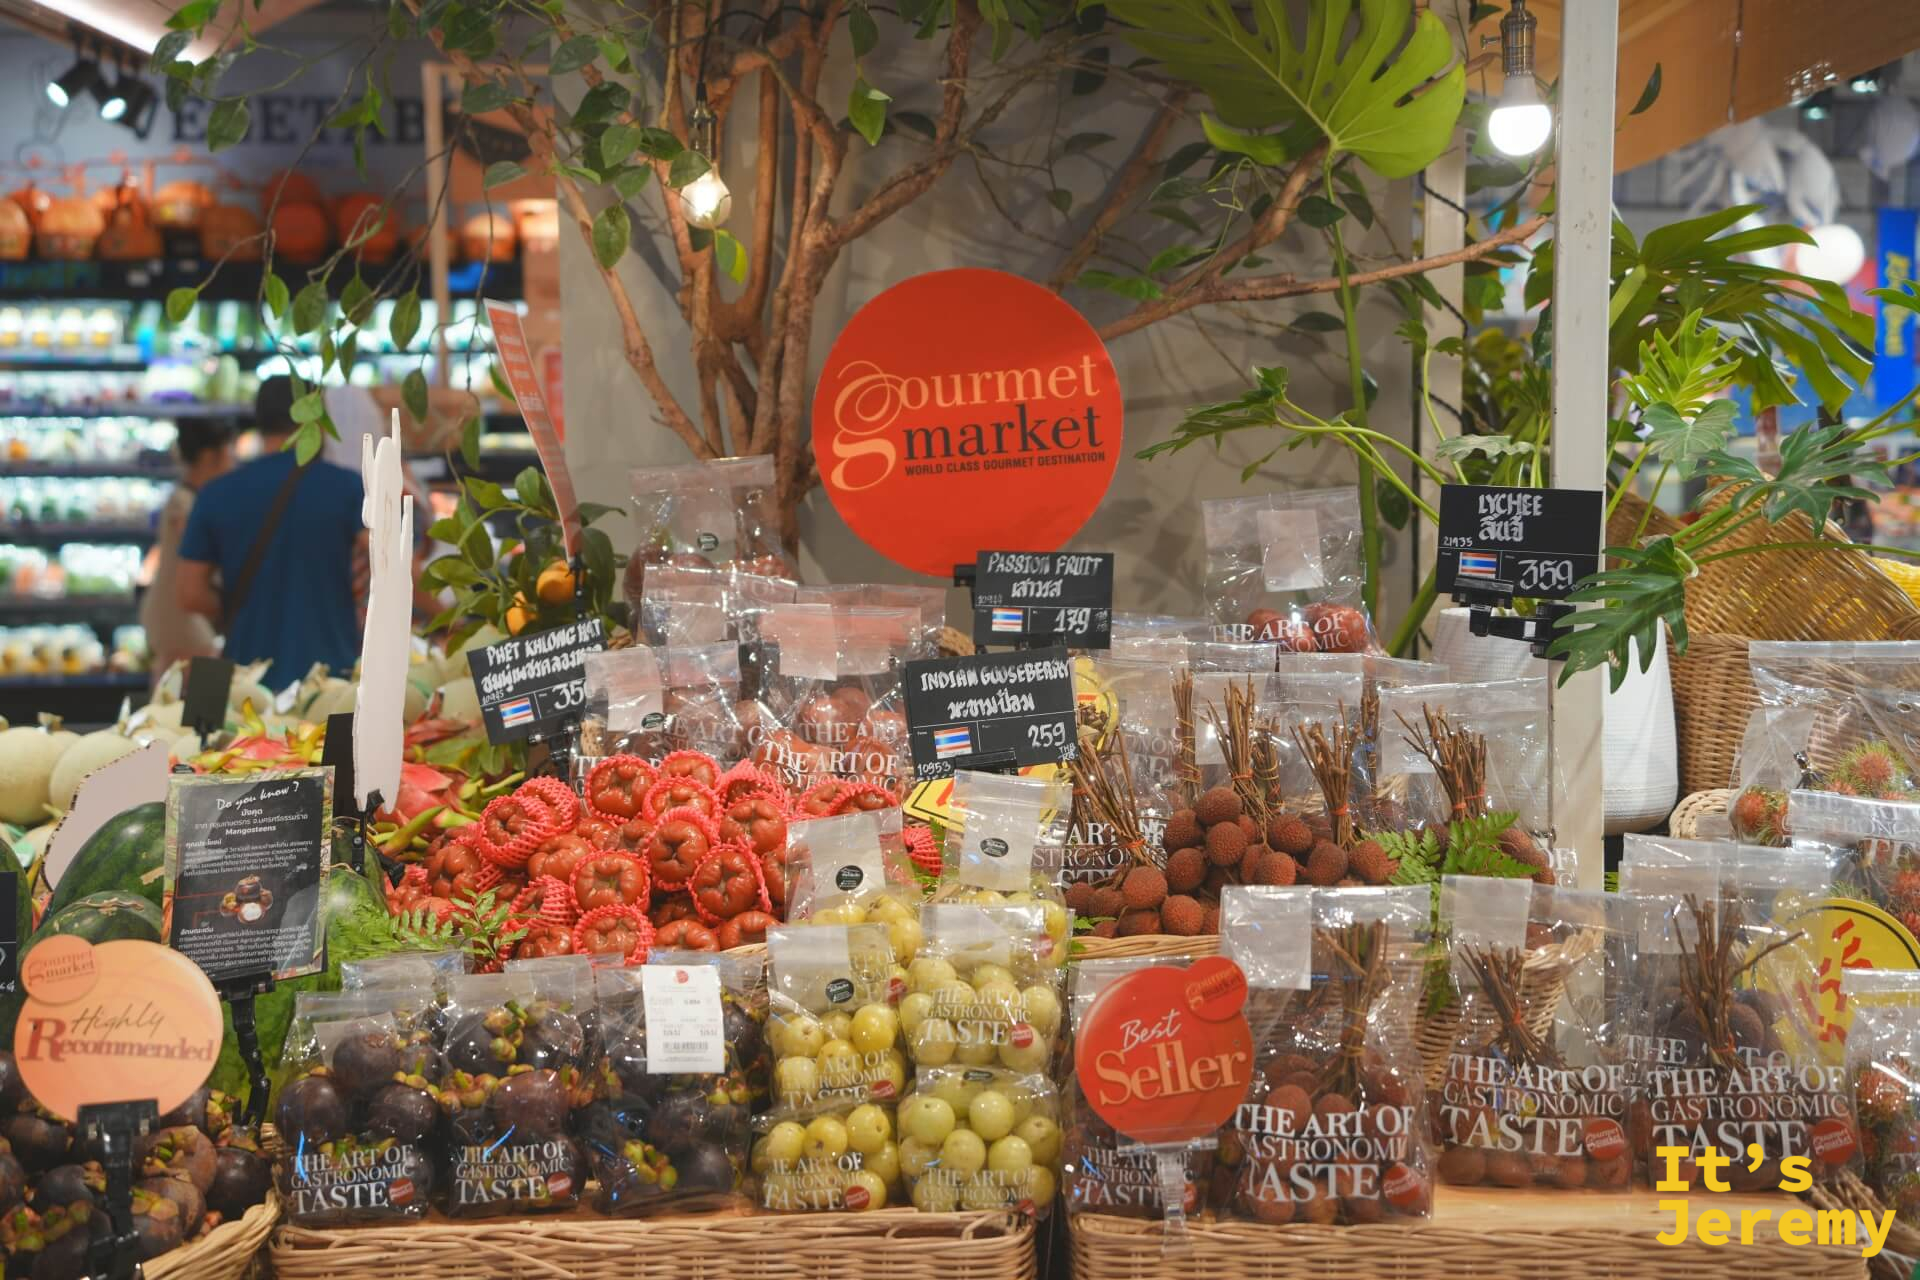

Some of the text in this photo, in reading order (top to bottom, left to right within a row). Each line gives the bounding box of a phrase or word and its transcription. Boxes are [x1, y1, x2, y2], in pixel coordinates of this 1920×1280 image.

[831, 354, 1100, 491] gourmet
[903, 403, 1104, 461] market
[905, 451, 1106, 477] WORLD CLASS GOURMET DESTINATION
[1478, 492, 1543, 516] LYCHEE
[987, 552, 1103, 576] PASSION FRUIT
[1517, 559, 1574, 590] 359
[1053, 607, 1091, 635] 179
[1259, 618, 1311, 641] ART
[1314, 612, 1346, 634] OF
[486, 641, 521, 666] PHET
[525, 626, 577, 657] KHLONG
[920, 657, 1071, 692] INDIAN GOOSEBERRY
[1027, 721, 1067, 749] 259
[813, 751, 864, 774] ART
[866, 751, 901, 776] OF
[216, 798, 233, 812] Do
[235, 794, 257, 811] you
[259, 785, 291, 802] know
[225, 825, 278, 837] Mangosteens
[71, 1001, 166, 1040] Highly
[923, 1018, 1009, 1047] TASTE
[1119, 1008, 1183, 1053] Best
[21, 1016, 216, 1063] Recommended
[864, 1048, 891, 1067] OF
[1095, 1039, 1247, 1107] Seller
[1449, 1053, 1509, 1086] THE
[1514, 1061, 1577, 1095] ART
[1582, 1064, 1625, 1093] OF
[1649, 1066, 1719, 1098] THE
[1727, 1065, 1791, 1095] ART
[1799, 1064, 1847, 1094] OF
[1444, 1081, 1626, 1117] GASTRONOMIC
[1651, 1093, 1850, 1123] GASTRONOMIC
[1234, 1103, 1417, 1138] THE ART OF
[1440, 1104, 1584, 1157] TASTE
[499, 1143, 540, 1163] ART
[543, 1139, 569, 1160] OF
[1243, 1132, 1408, 1162] ASTRONOMI
[1652, 1119, 1811, 1163] TASTE
[290, 1143, 414, 1174] THE ART OF
[456, 1156, 572, 1179] GASTRONOMIC
[838, 1151, 864, 1173] OF
[290, 1160, 416, 1189] GASTRONOMIC
[968, 1168, 1009, 1187] ART
[289, 1181, 389, 1215] TASTE
[455, 1175, 548, 1205] TASTE
[762, 1182, 843, 1211] TASTE
